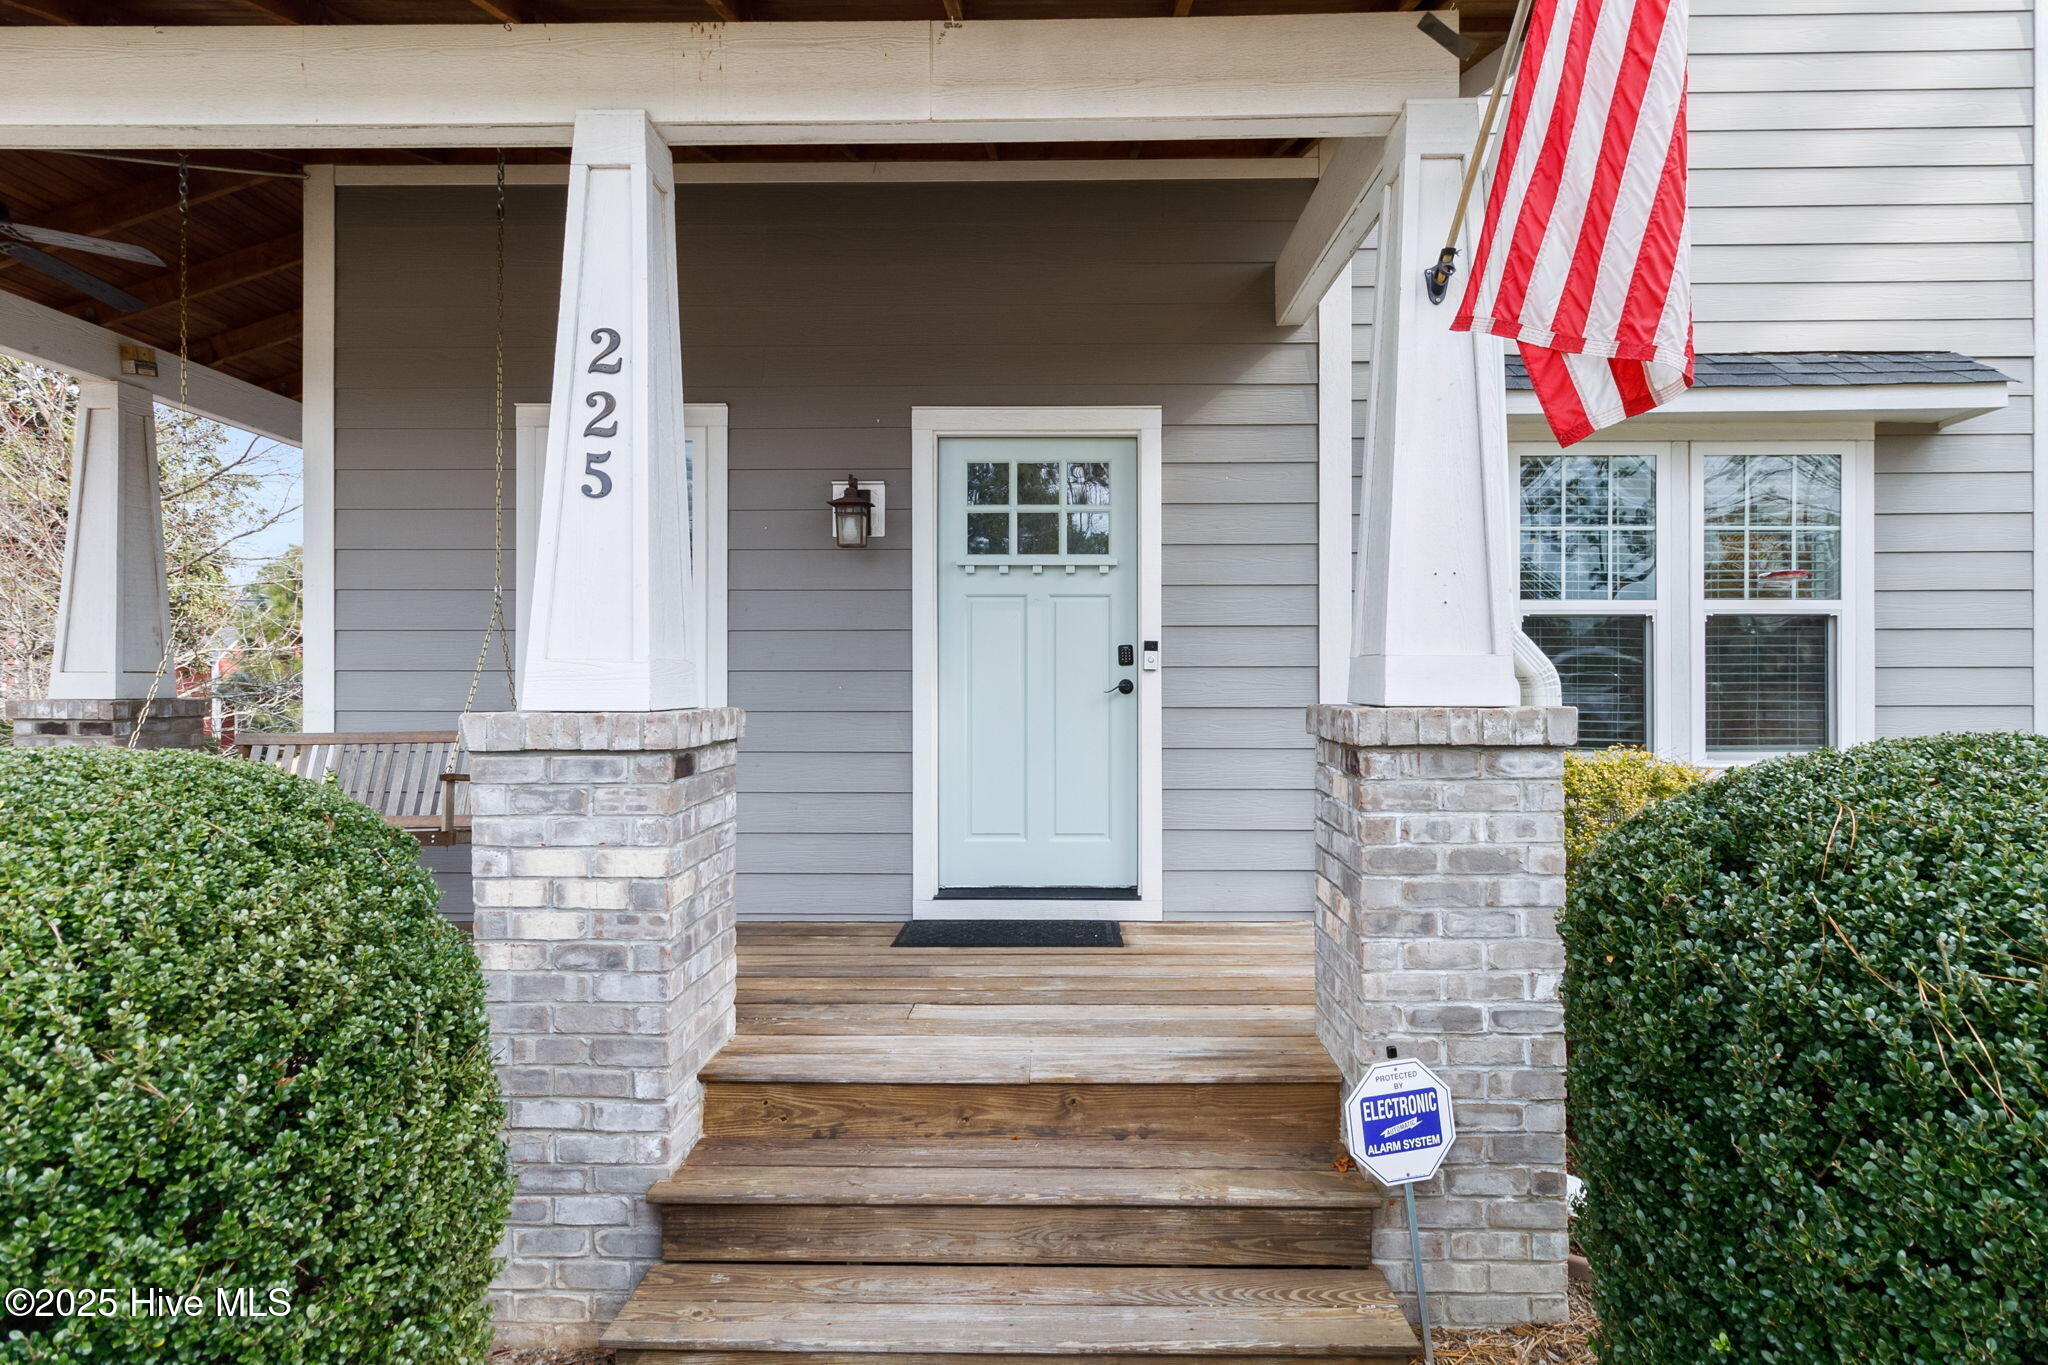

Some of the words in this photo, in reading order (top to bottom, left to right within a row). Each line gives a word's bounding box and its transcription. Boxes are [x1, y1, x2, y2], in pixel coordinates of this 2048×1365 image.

[581, 327, 623, 499] 225
[1375, 1070, 1418, 1082] PROTECTED
[1393, 1082, 1403, 1090] BY
[1362, 1091, 1438, 1122] ELECTRONIC
[1386, 1119, 1417, 1136] AUTOMATIC
[1367, 1141, 1401, 1156] ALARM
[1403, 1134, 1441, 1150] SYSTEM
